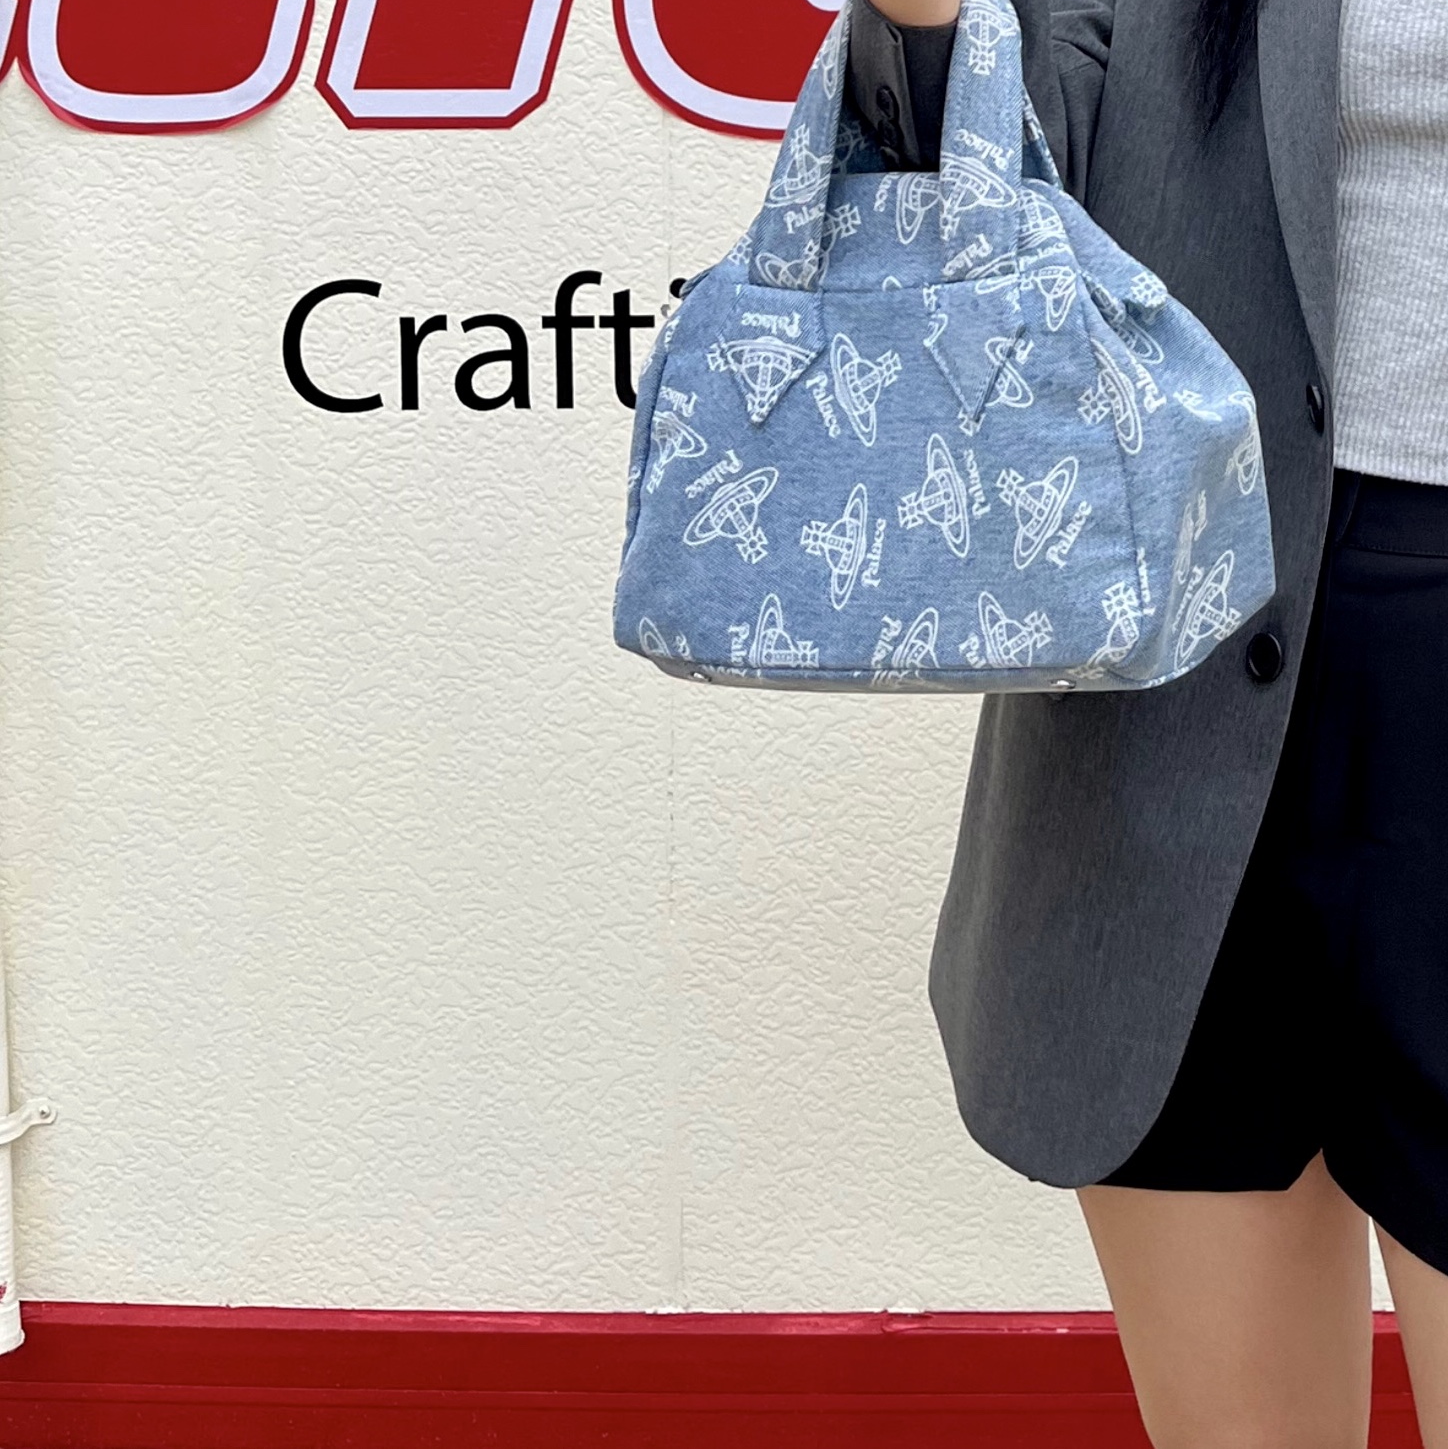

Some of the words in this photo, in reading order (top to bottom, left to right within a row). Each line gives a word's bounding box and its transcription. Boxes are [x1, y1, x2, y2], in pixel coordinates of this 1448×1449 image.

[953, 128, 1014, 172] Palace
[282, 270, 688, 413] Craft
[742, 312, 801, 338] Palace
[806, 370, 841, 438] Palace
[684, 450, 743, 499] Palace
[963, 449, 992, 520] Palace
[861, 517, 887, 588] Palace
[1046, 501, 1092, 569] Palace
